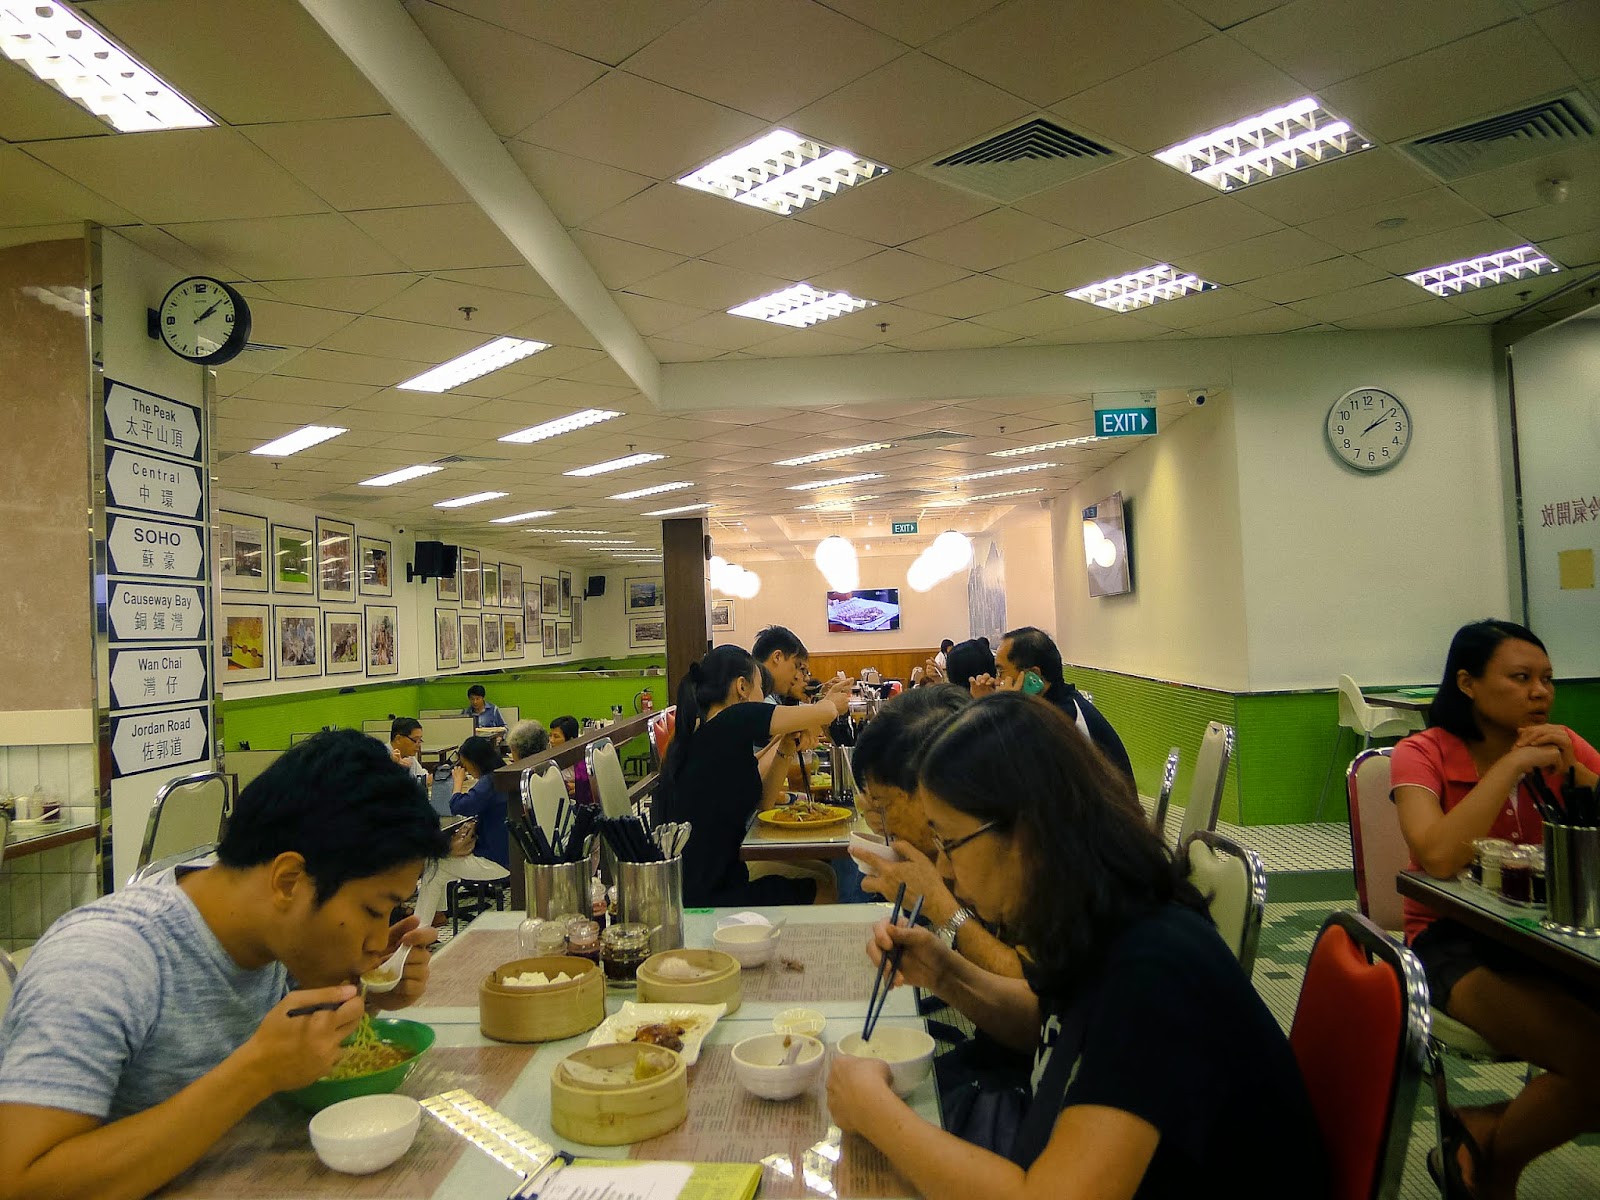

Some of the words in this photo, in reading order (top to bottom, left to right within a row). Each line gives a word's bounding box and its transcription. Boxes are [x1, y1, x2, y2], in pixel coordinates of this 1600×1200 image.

[194, 284, 207, 293] 12
[225, 314, 234, 323] 3
[1350, 400, 1359, 410] 11
[1362, 395, 1373, 406] 12
[1380, 399, 1384, 408] 1
[132, 398, 151, 414] The
[153, 404, 176, 423] Peak
[1340, 410, 1350, 421] 10
[1390, 408, 1397, 418] 2
[1103, 412, 1138, 433] EXIT
[1395, 422, 1402, 432] 3
[126, 415, 184, 449] 太平山頂
[1337, 425, 1344, 435] 9
[1343, 438, 1351, 449] 8
[1392, 436, 1400, 446] 4
[1354, 448, 1360, 459] 7
[1368, 451, 1375, 461] 6
[1382, 447, 1389, 457] 5
[132, 462, 180, 485] Central
[139, 484, 174, 509] 中環
[895, 524, 910, 533] EXIT
[134, 527, 181, 547] SOHO
[123, 591, 172, 609] Causeway
[175, 594, 192, 610] Bay
[138, 658, 159, 671] Wan
[162, 656, 182, 670] Chai
[143, 675, 178, 698] 灣仔
[131, 721, 165, 738] Jordan
[167, 717, 191, 732] Road
